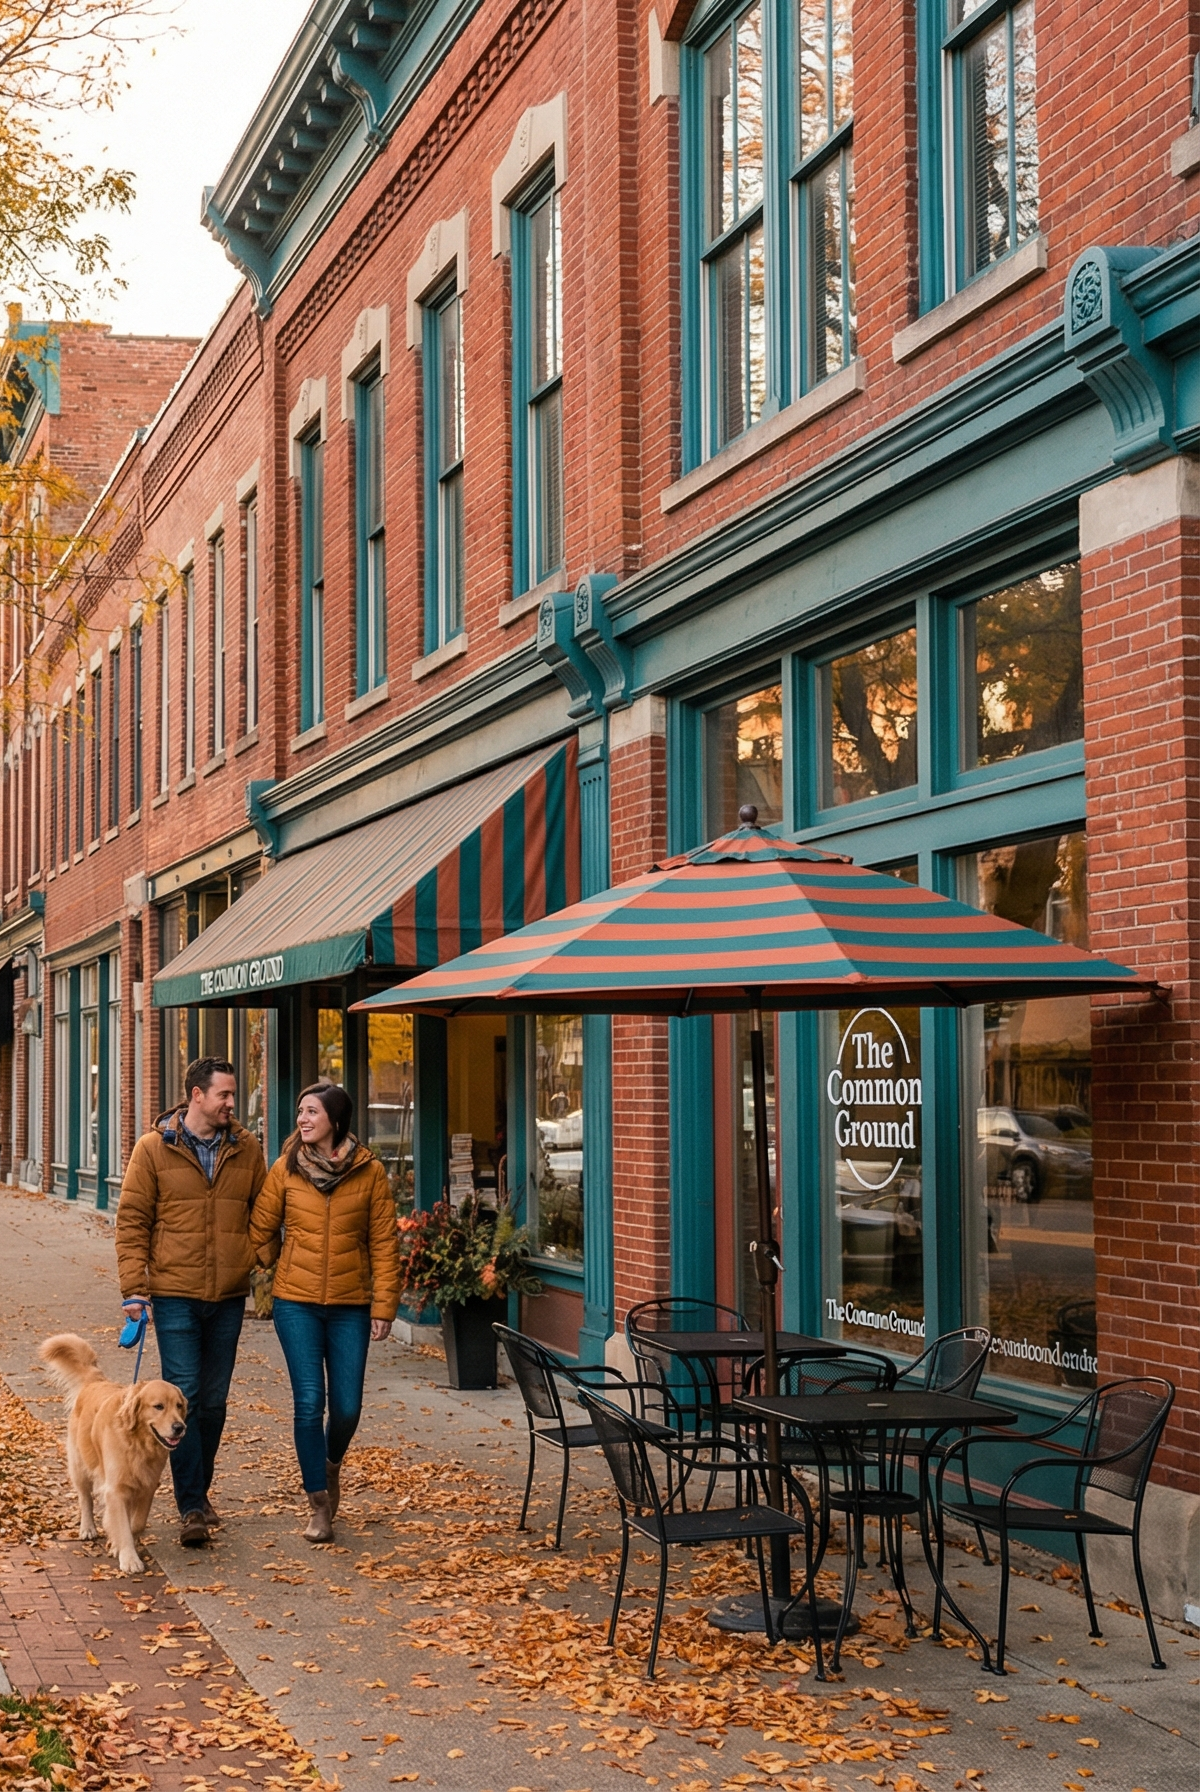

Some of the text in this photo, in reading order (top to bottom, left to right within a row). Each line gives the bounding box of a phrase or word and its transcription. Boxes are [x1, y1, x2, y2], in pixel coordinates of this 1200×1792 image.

[851, 1031, 894, 1069] The
[827, 1069, 923, 1106] Common
[834, 1109, 916, 1149] Ground
[825, 1298, 845, 1322] The
